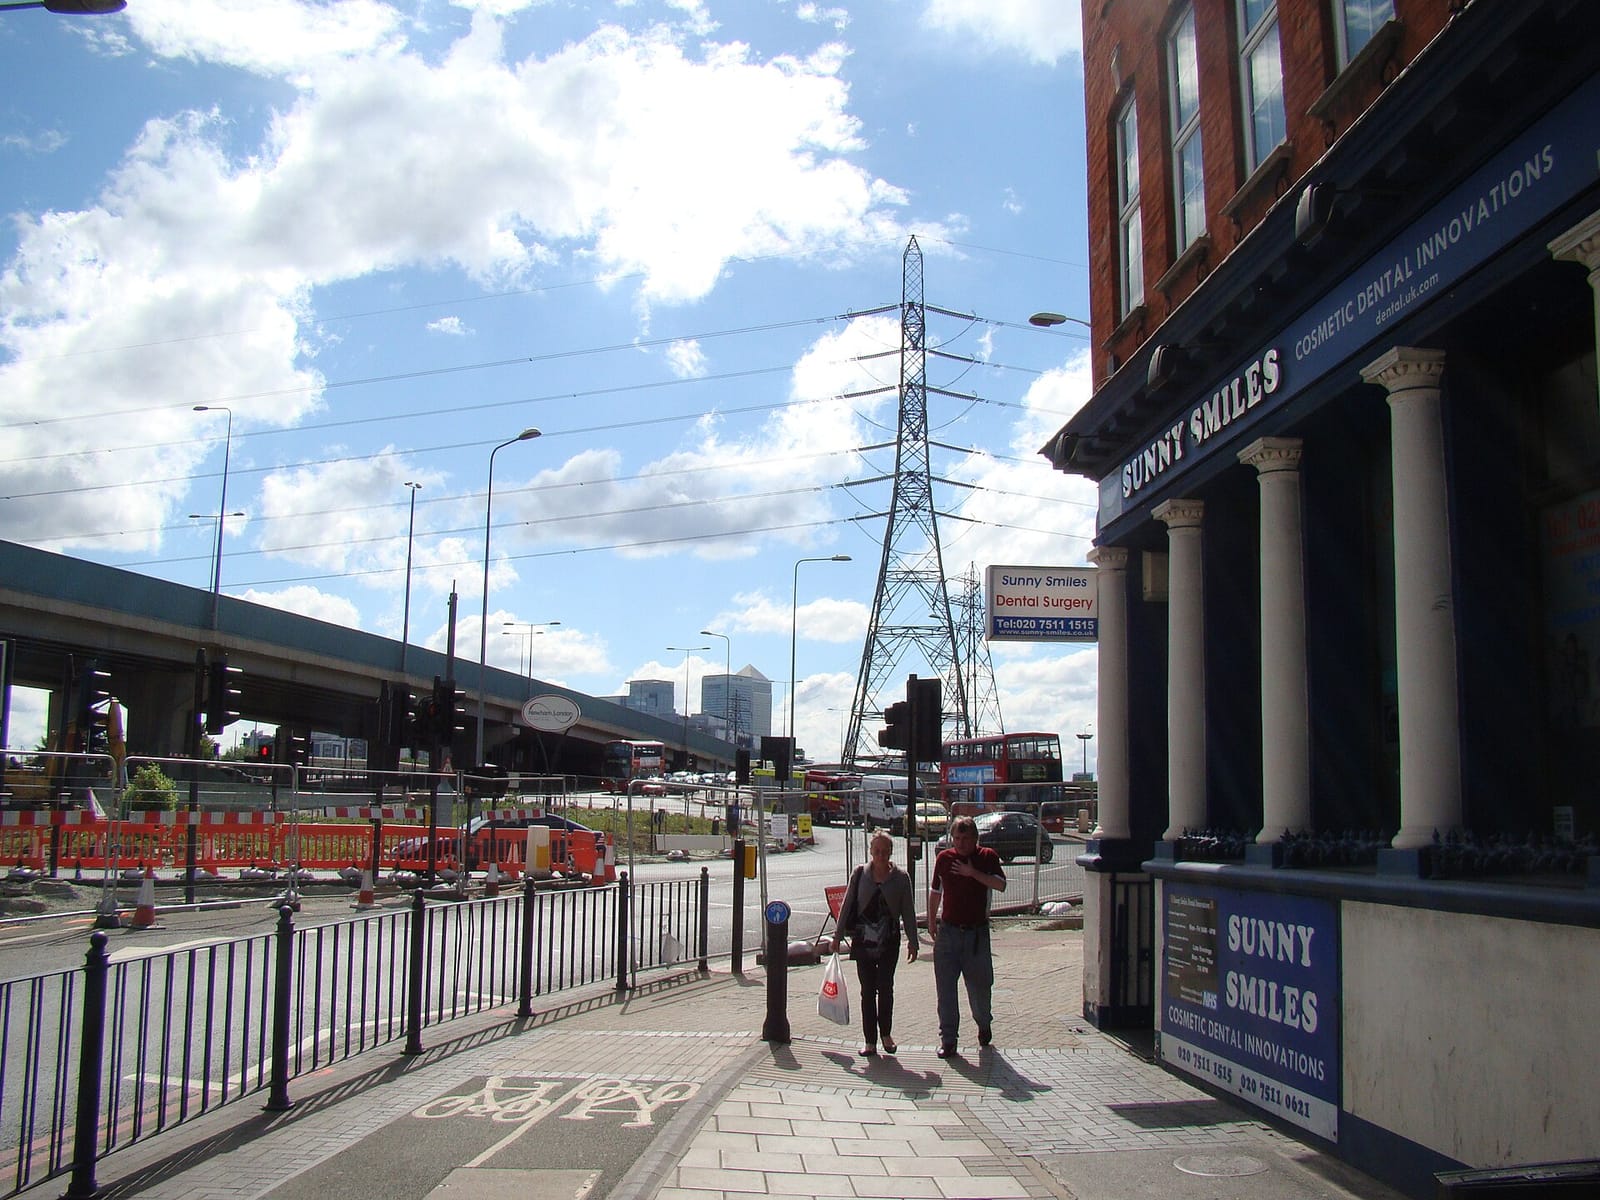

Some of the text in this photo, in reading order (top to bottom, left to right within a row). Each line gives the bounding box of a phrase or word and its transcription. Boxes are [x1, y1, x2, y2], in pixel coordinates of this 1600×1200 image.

[1295, 144, 1554, 361] COSMETIC DENTAL INNOVATIONS
[1375, 272, 1439, 326] dental.uk.com
[1122, 348, 1280, 498] SUNNY SMILES
[996, 594, 1093, 610] Dental Surgery
[1001, 575, 1087, 588] Sunny Smiles
[997, 619, 1094, 630] Tel:020 7511 1515
[1228, 914, 1315, 967] SUNNY
[1226, 970, 1318, 1034] SMILES
[1168, 1005, 1325, 1081] COSMETIC DENTAL INNOVATIONS
[1177, 1046, 1310, 1118] 020 7511 1515 020 7511 0621
